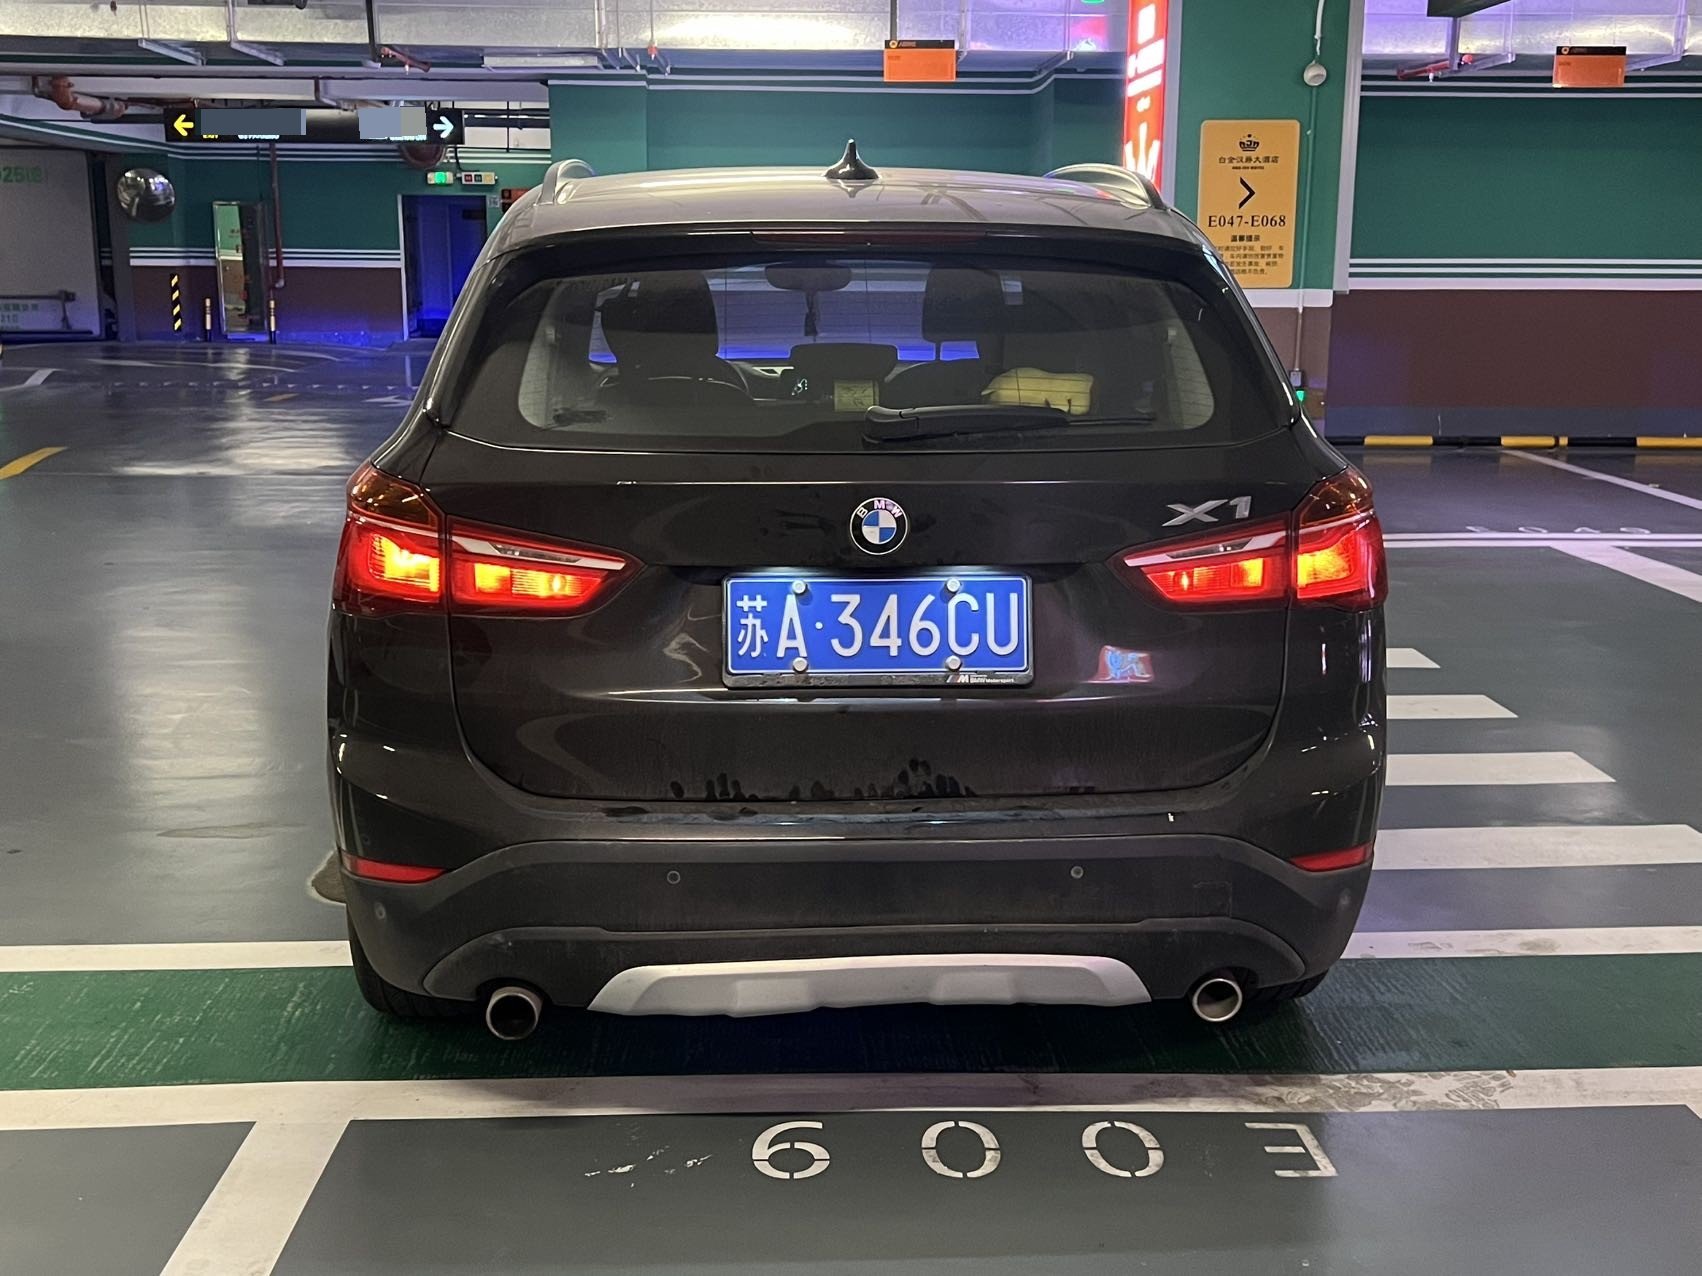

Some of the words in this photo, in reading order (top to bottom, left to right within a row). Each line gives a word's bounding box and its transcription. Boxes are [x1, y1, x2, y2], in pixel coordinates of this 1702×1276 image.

[1208, 215, 1286, 228] E047-E068
[857, 500, 903, 518] BMW
[1162, 496, 1252, 527] X1
